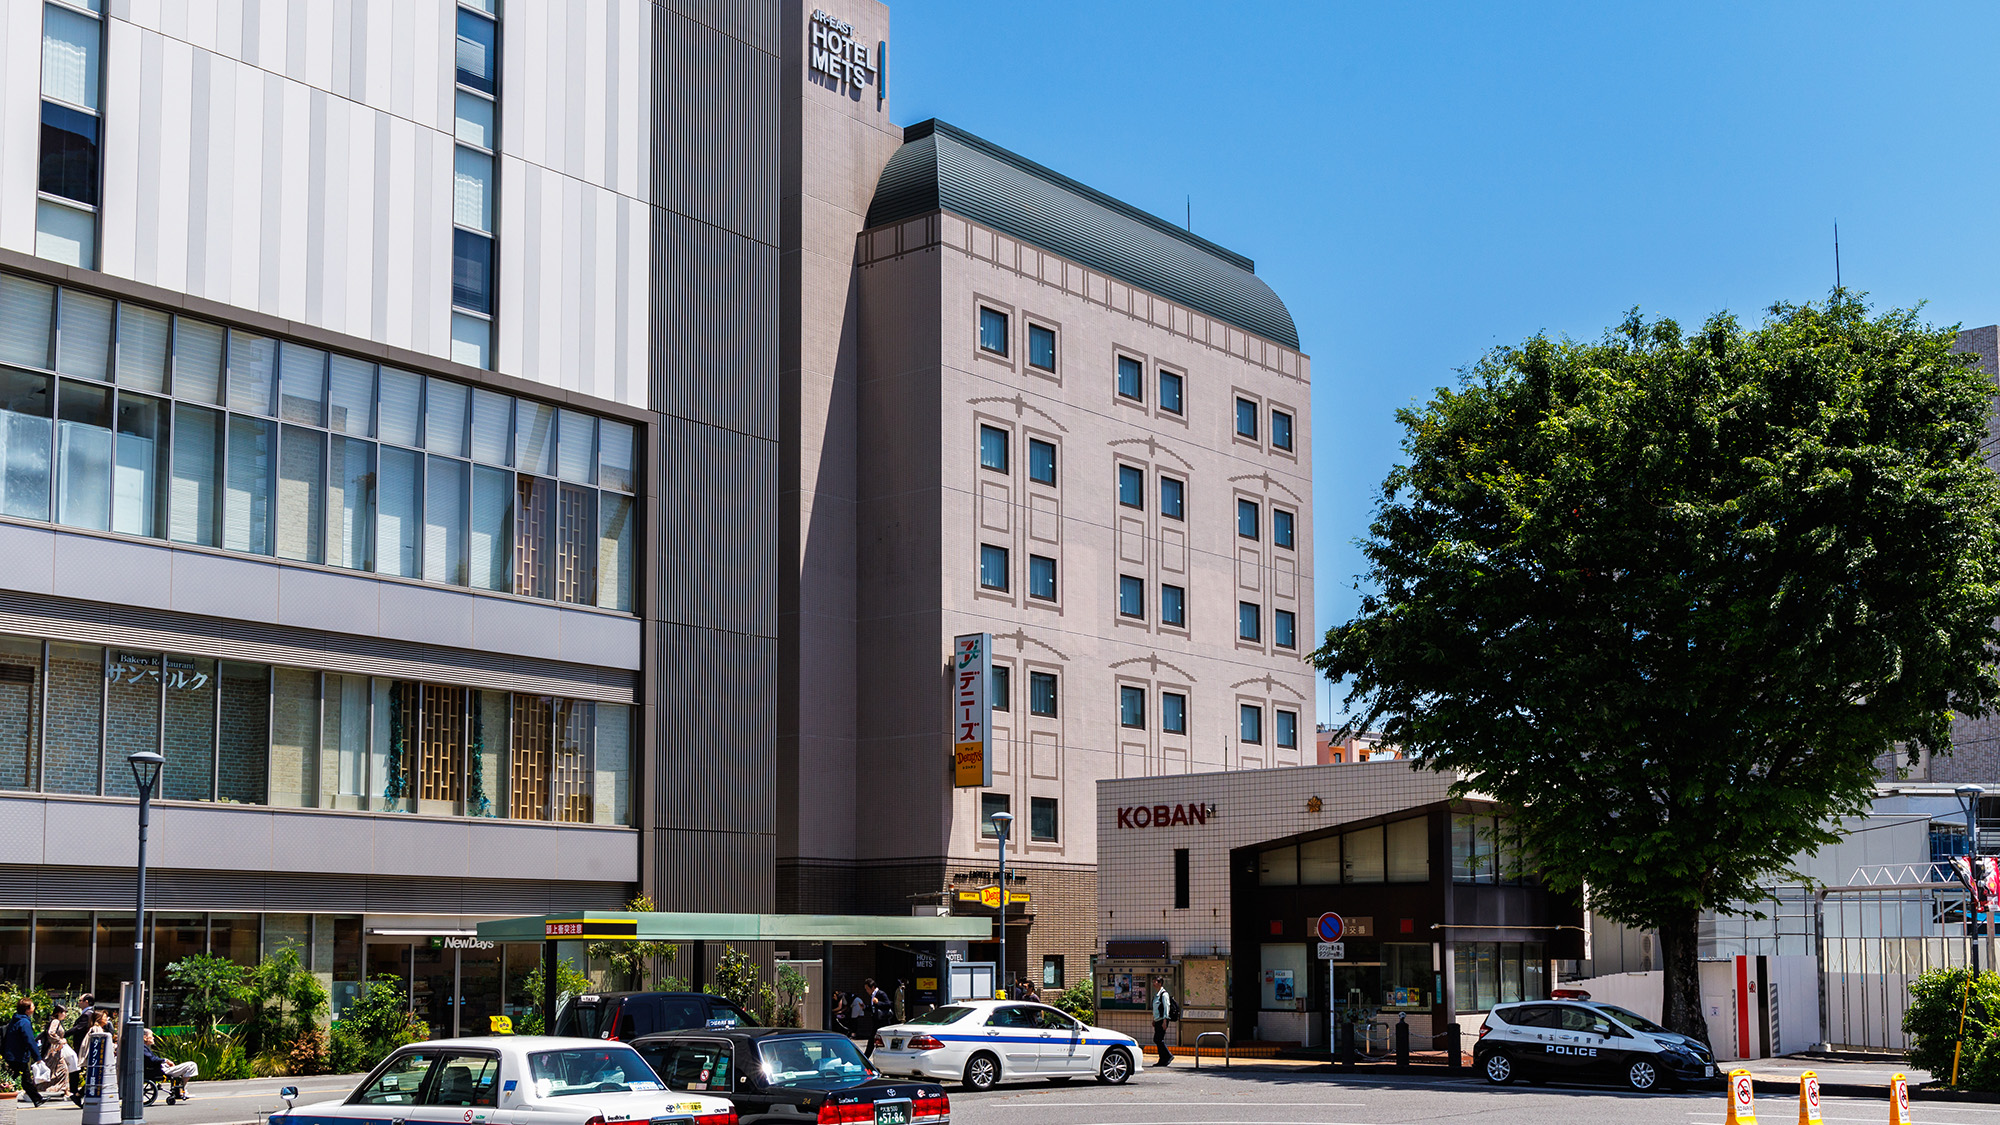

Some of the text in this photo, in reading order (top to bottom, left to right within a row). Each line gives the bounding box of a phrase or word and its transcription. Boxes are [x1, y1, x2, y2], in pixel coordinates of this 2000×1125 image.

[812, 9, 855, 37] JR-EAST
[812, 22, 877, 73] HOTEL
[812, 46, 866, 89] METS
[120, 654, 149, 666] Bakery
[960, 671, 980, 741] デニーズ
[957, 750, 982, 765] Denny's
[1117, 802, 1206, 829] KOBAN
[444, 936, 494, 950] NewDays
[916, 960, 933, 968] METS
[1537, 1033, 1604, 1044] 埼玉県警察
[1546, 1045, 1598, 1057] POLICE
[802, 1097, 811, 1105] 24
